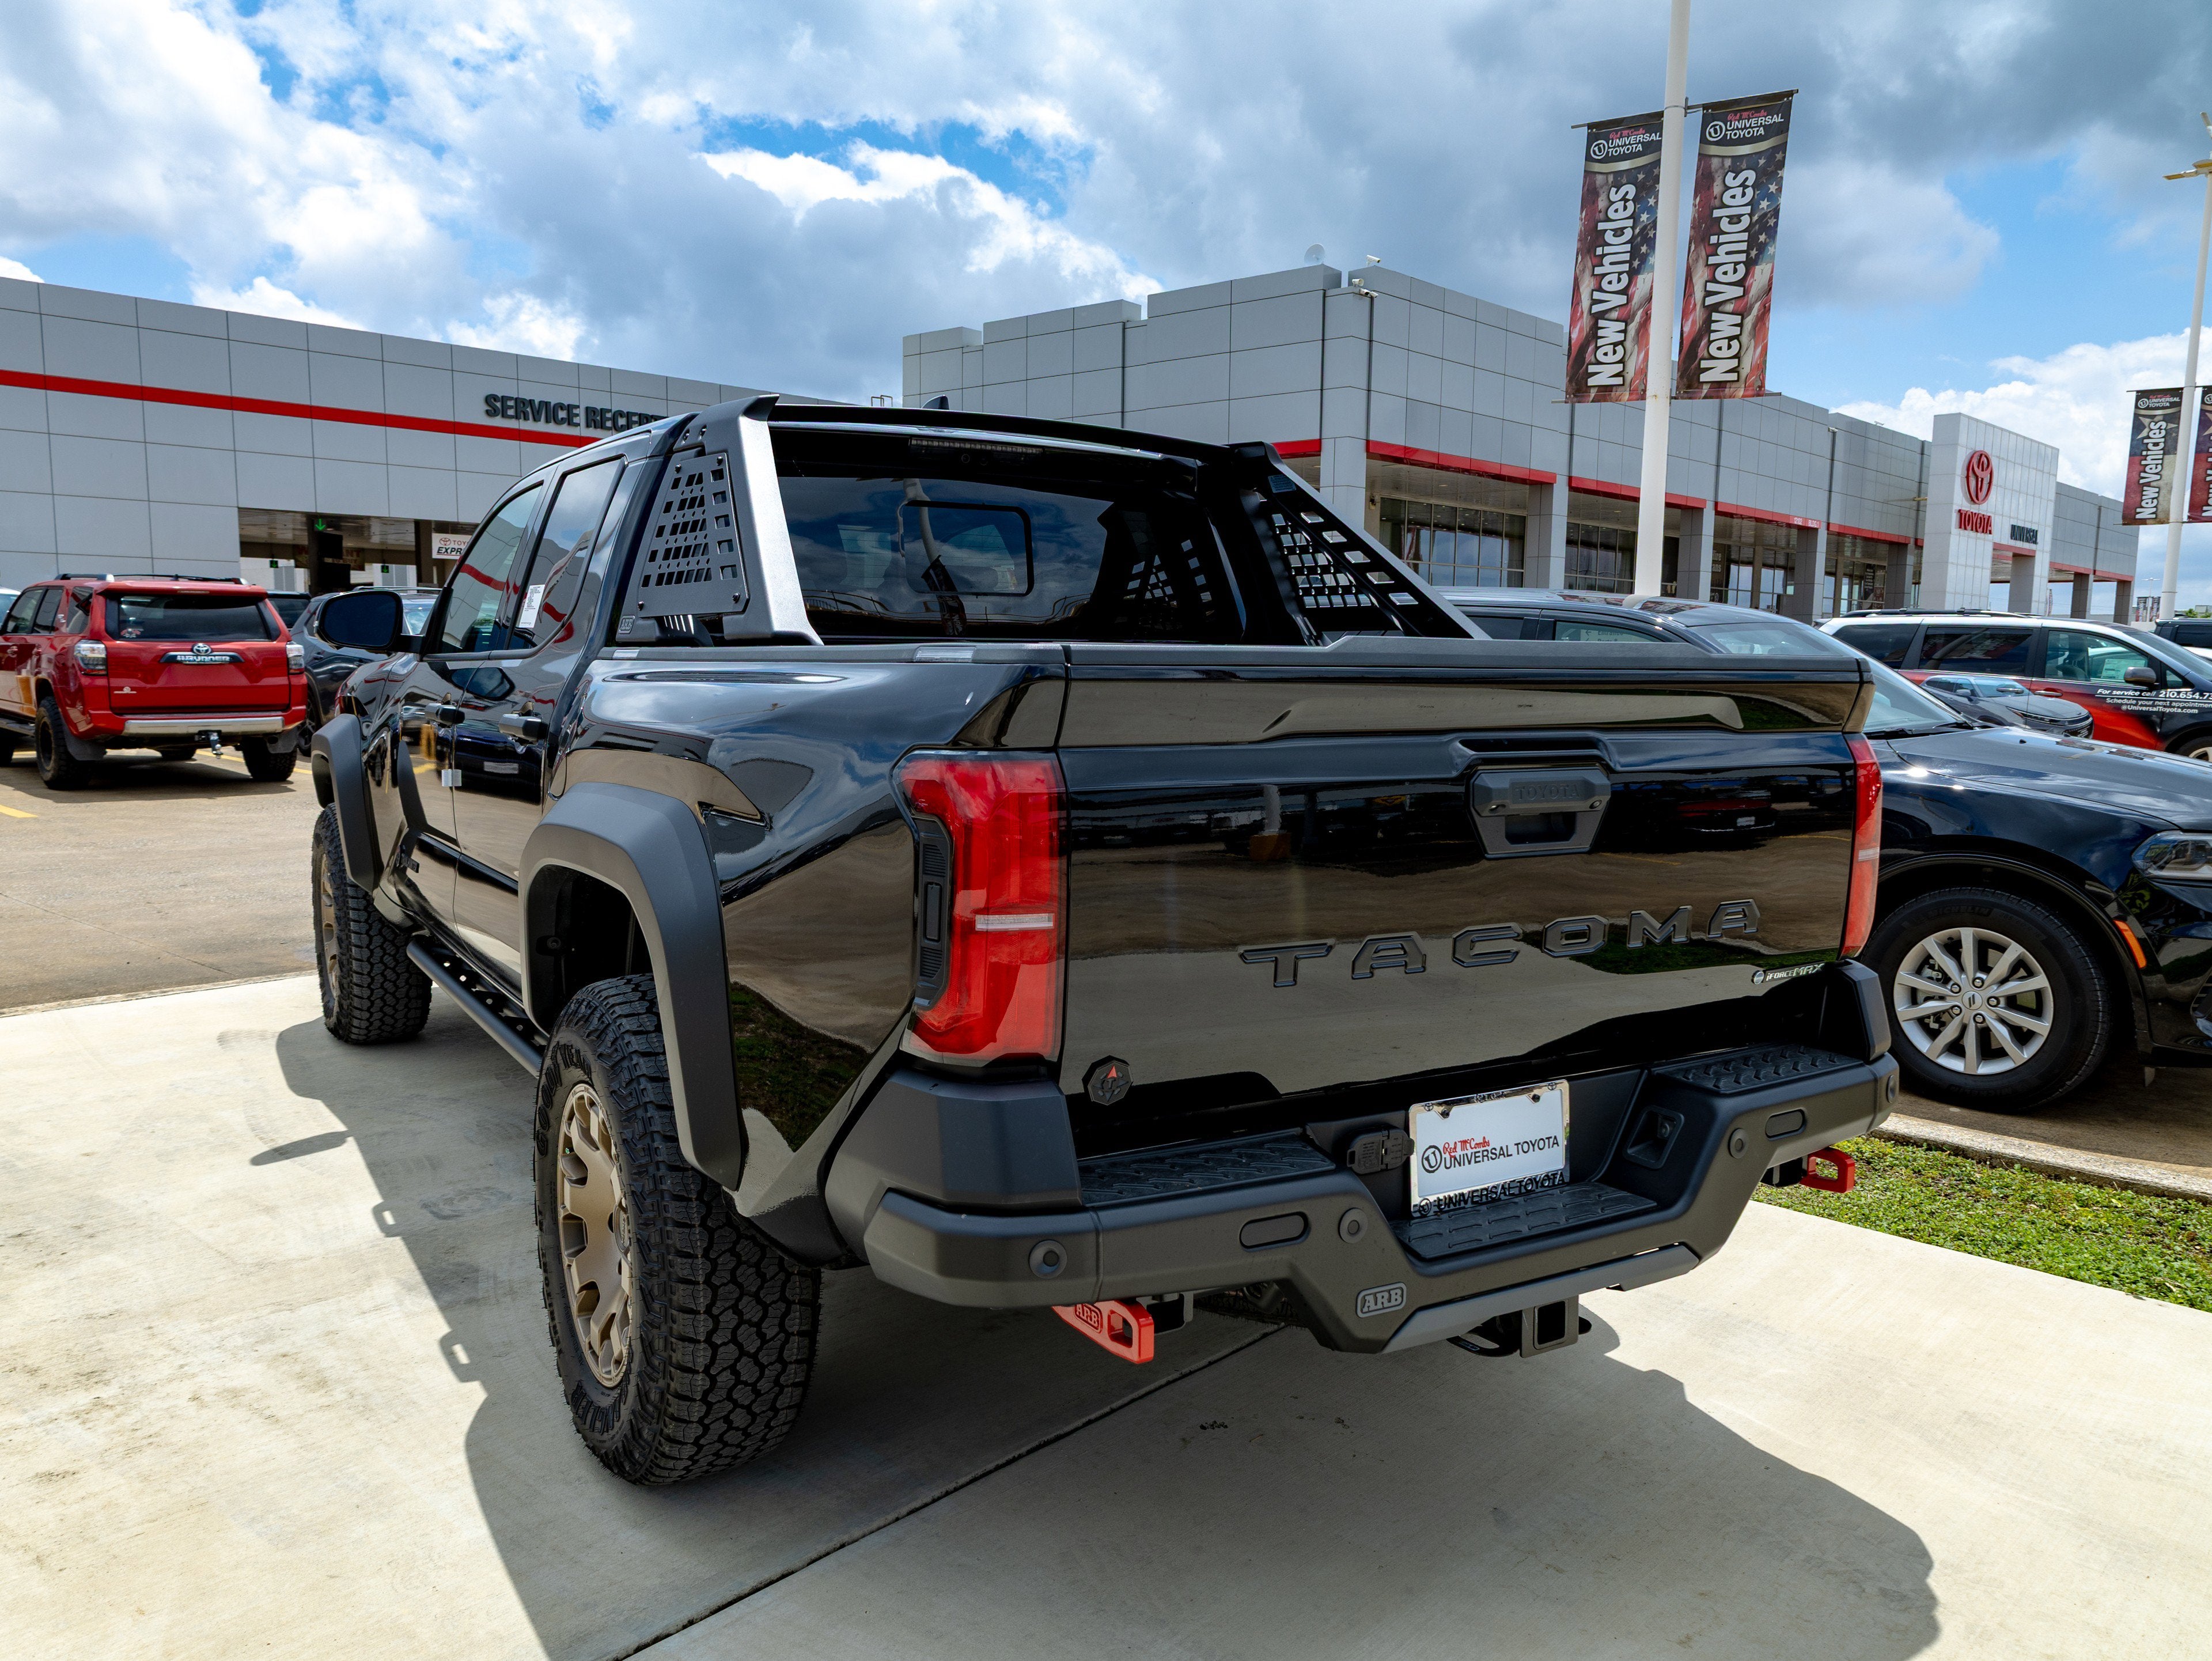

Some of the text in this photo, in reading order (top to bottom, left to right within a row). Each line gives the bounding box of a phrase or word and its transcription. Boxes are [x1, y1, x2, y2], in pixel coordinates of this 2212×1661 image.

[1726, 127, 1764, 139] TOYOTA
[1727, 113, 1784, 130] UNIVERSAL
[1608, 143, 1642, 157] TOYOTA
[1609, 132, 1662, 147] UNIVERSAL
[1587, 183, 1637, 386] New Vehicles
[1699, 169, 1756, 383] New Vehicles
[485, 394, 580, 427] SERVICE
[2139, 421, 2167, 484] Vehicles
[2135, 486, 2160, 519] New
[1958, 509, 1993, 535] TOYOTA
[2010, 524, 2038, 544] UNIVERSAL
[620, 618, 632, 631] ARB
[2121, 705, 2198, 713] @UniversalToyota.com
[1514, 784, 1580, 801] TOYOTA
[1238, 898, 1761, 987] TACOMA
[536, 1041, 592, 1157] GOODYEAR
[1442, 1141, 1457, 1158] Red
[1444, 1135, 1560, 1170] UNIVERSAL TOYOTA
[1436, 1171, 1566, 1211] UNIVERSAL TOYOTA
[1361, 1288, 1402, 1312] ARB
[1076, 1303, 1098, 1327] ARB
